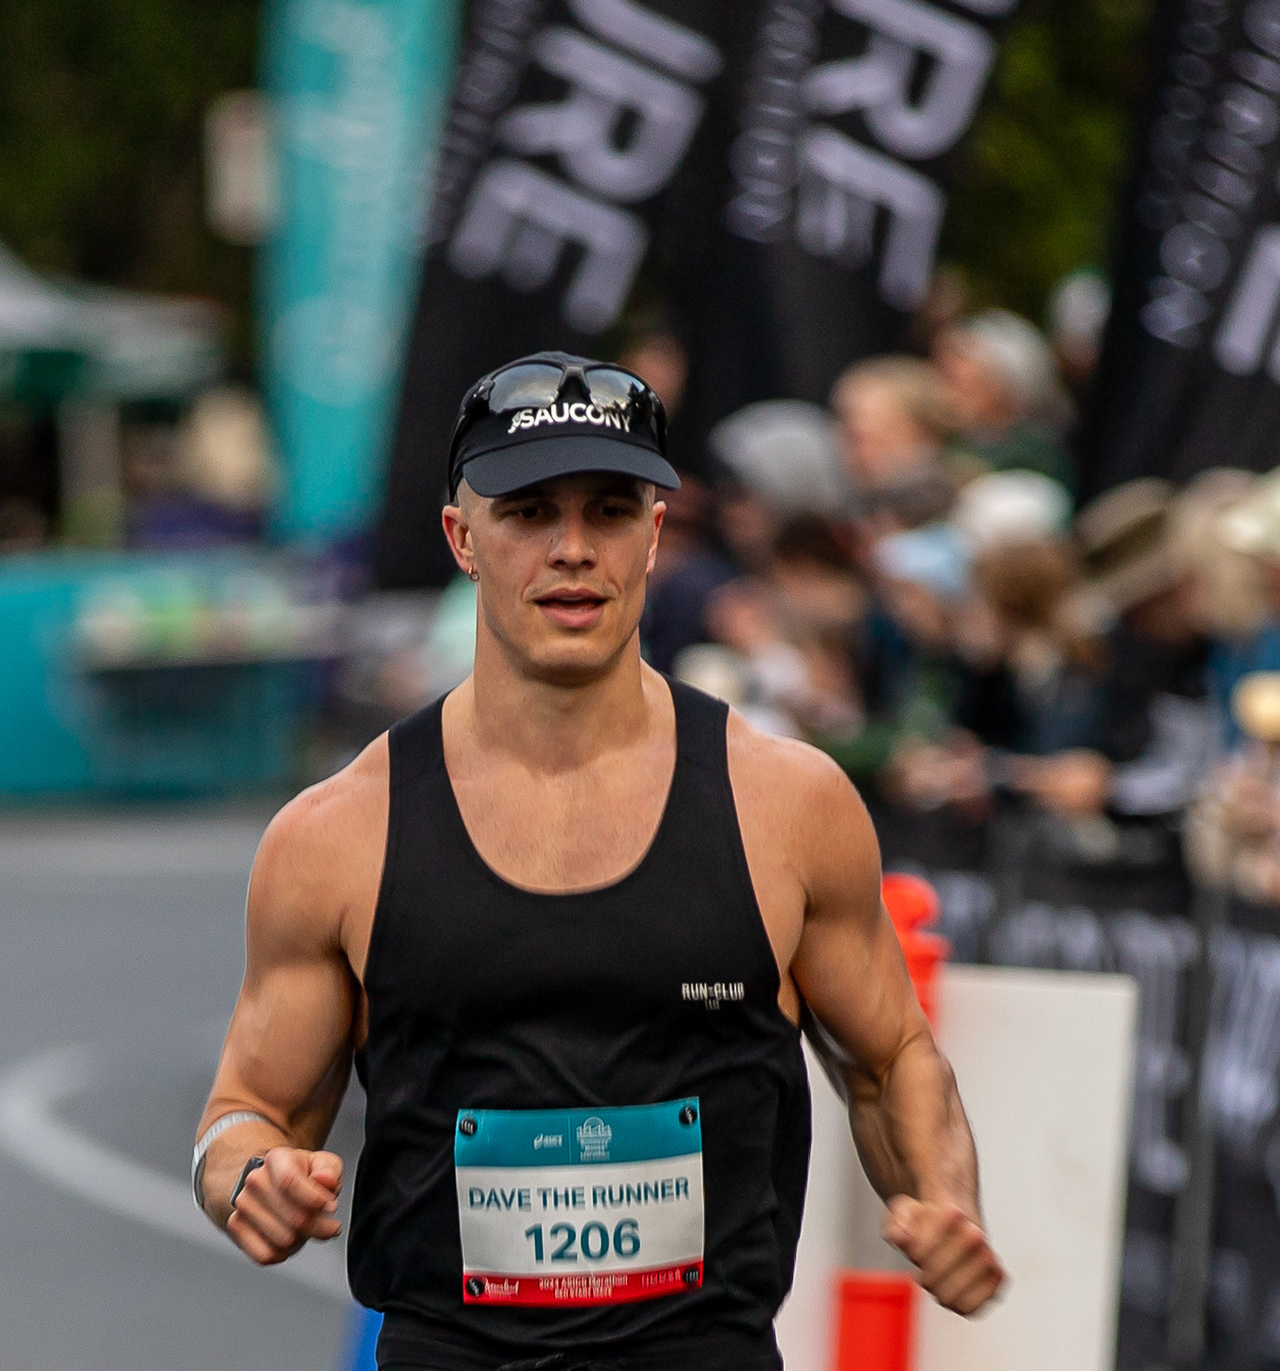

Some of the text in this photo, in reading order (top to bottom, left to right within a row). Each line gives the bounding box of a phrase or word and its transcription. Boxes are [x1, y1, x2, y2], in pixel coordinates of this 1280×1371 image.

[794, 0, 1018, 312] RE
[518, 402, 631, 433] SAUCONY
[468, 1176, 690, 1212] DAVE THE RUNNER
[524, 1217, 642, 1265] 1206
